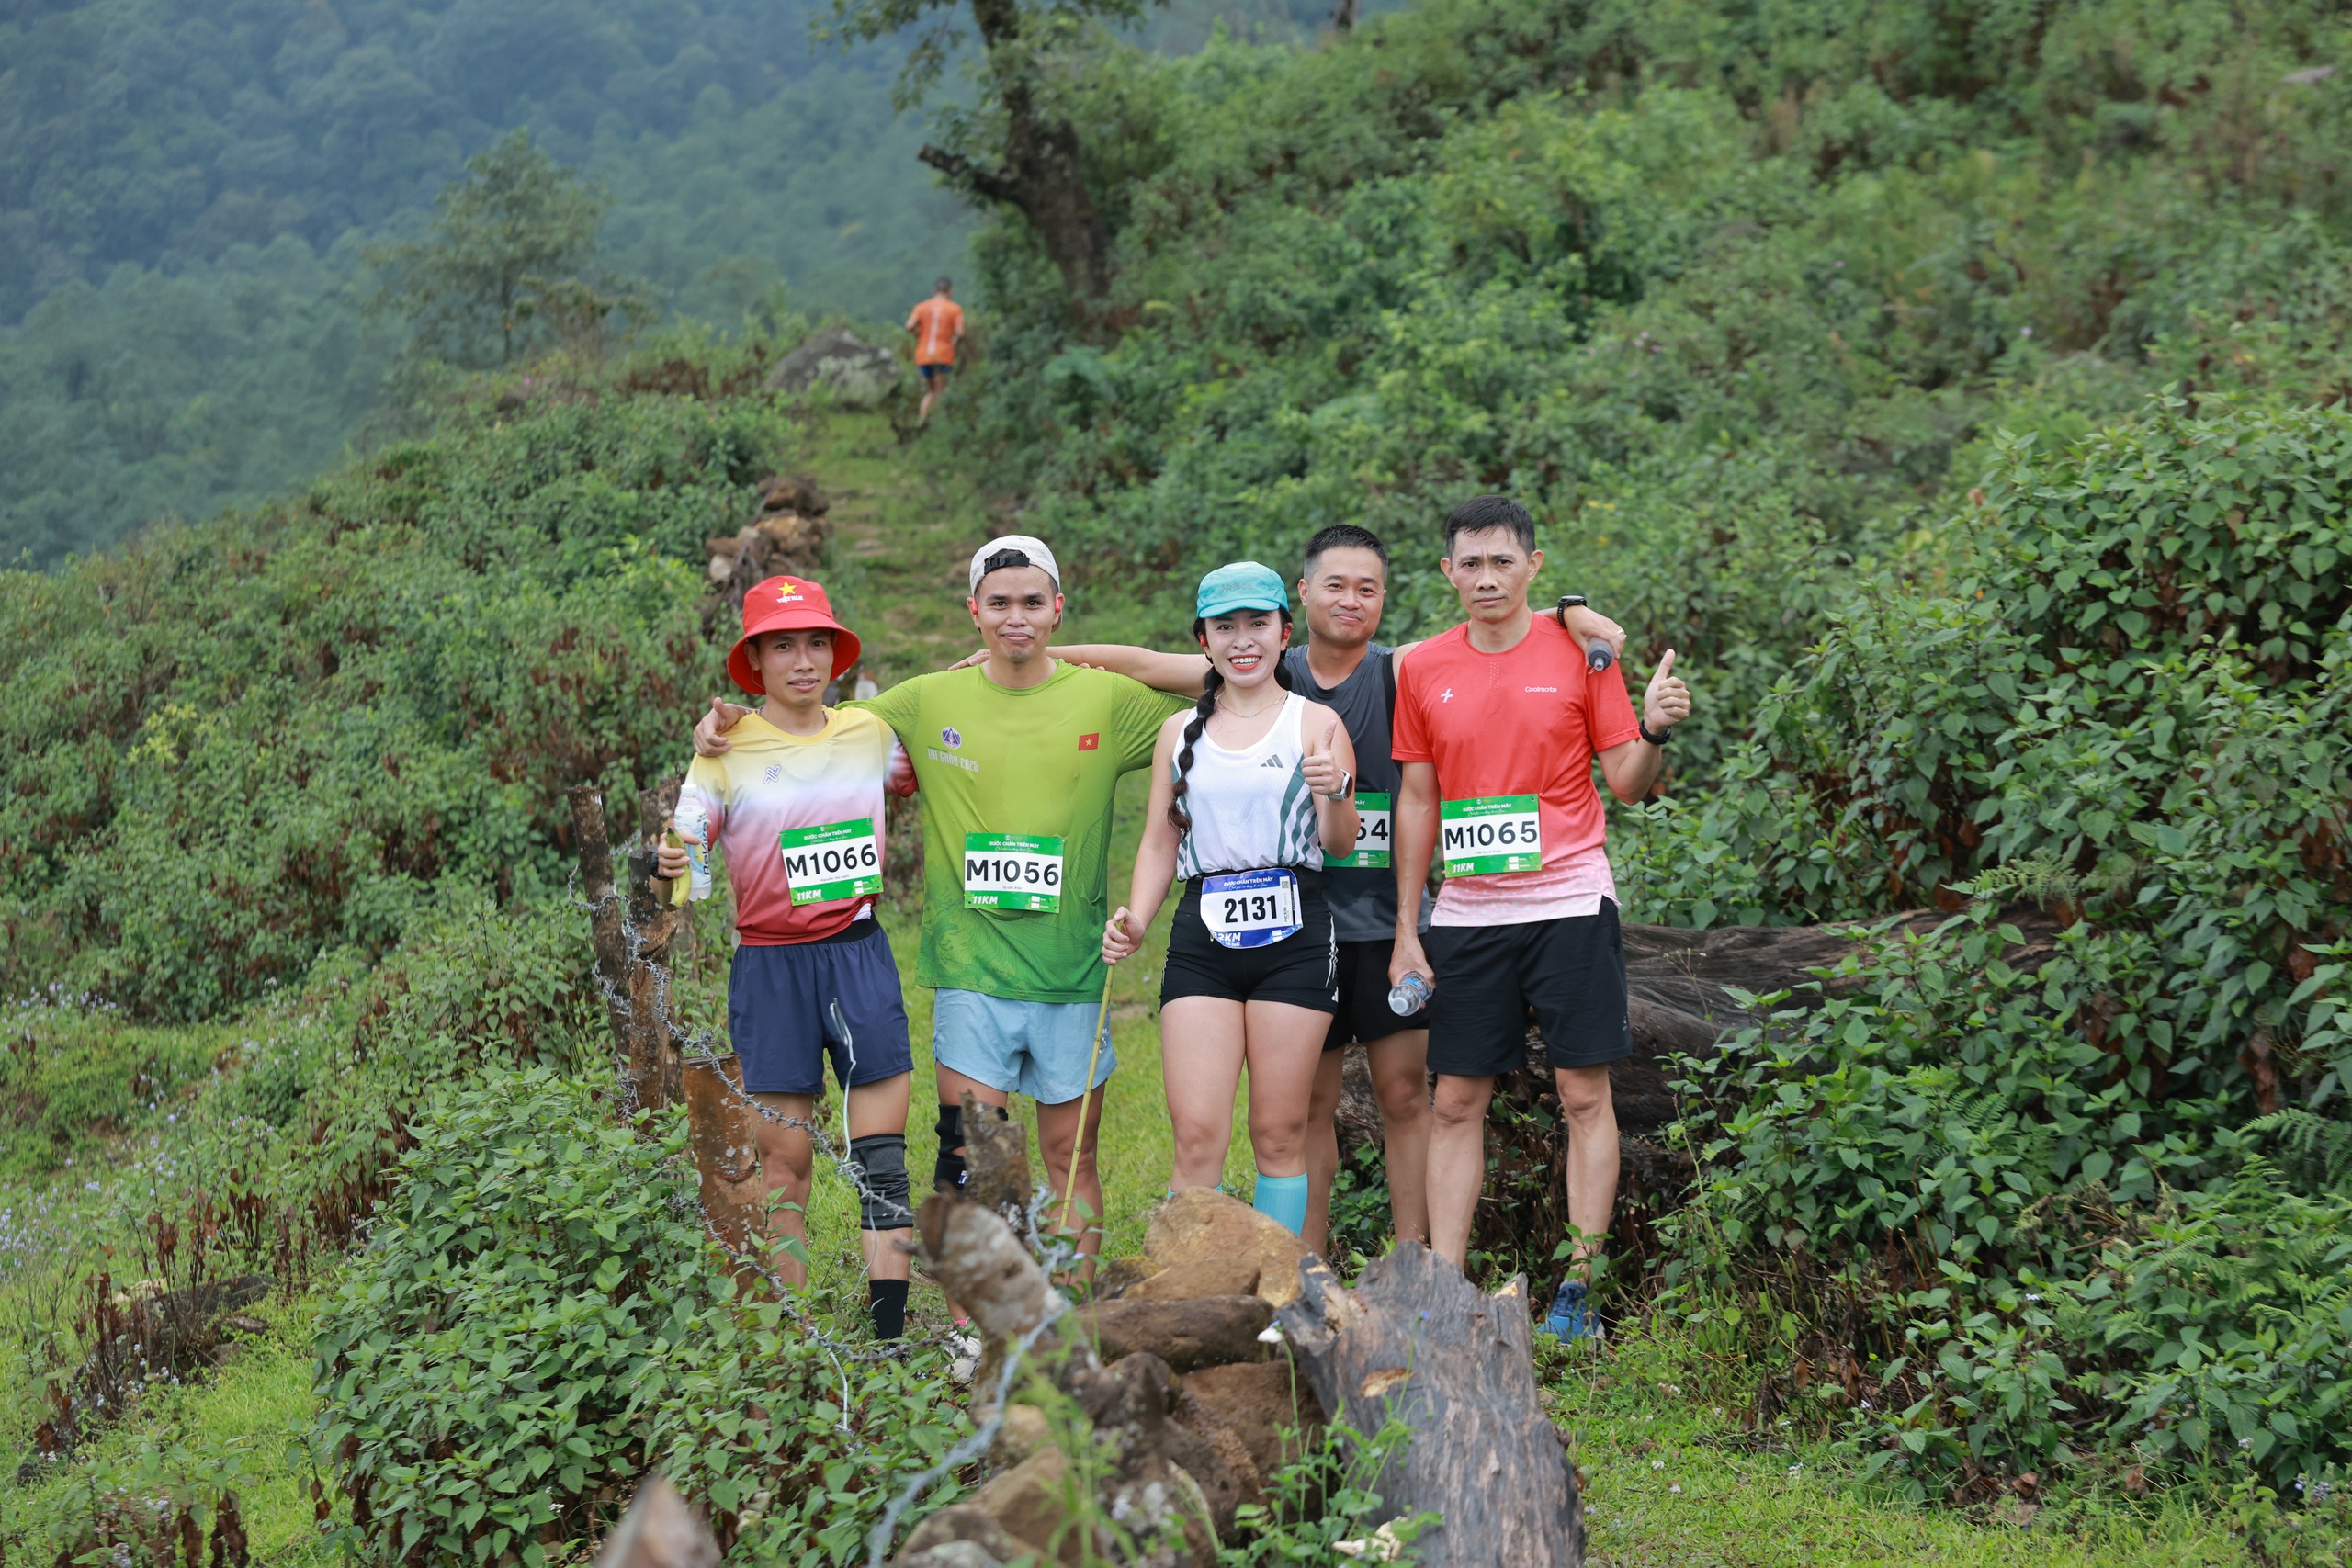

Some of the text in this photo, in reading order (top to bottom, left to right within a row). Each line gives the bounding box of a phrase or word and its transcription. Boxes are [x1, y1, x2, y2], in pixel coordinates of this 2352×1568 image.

[1444, 820, 1538, 851] M1065
[786, 843, 876, 879] M1066
[967, 859, 1059, 886] M1056
[1453, 862, 1475, 873] 11KM
[797, 888, 822, 900] 11KM
[972, 896, 999, 904] 11KM
[1224, 895, 1277, 923] 2131
